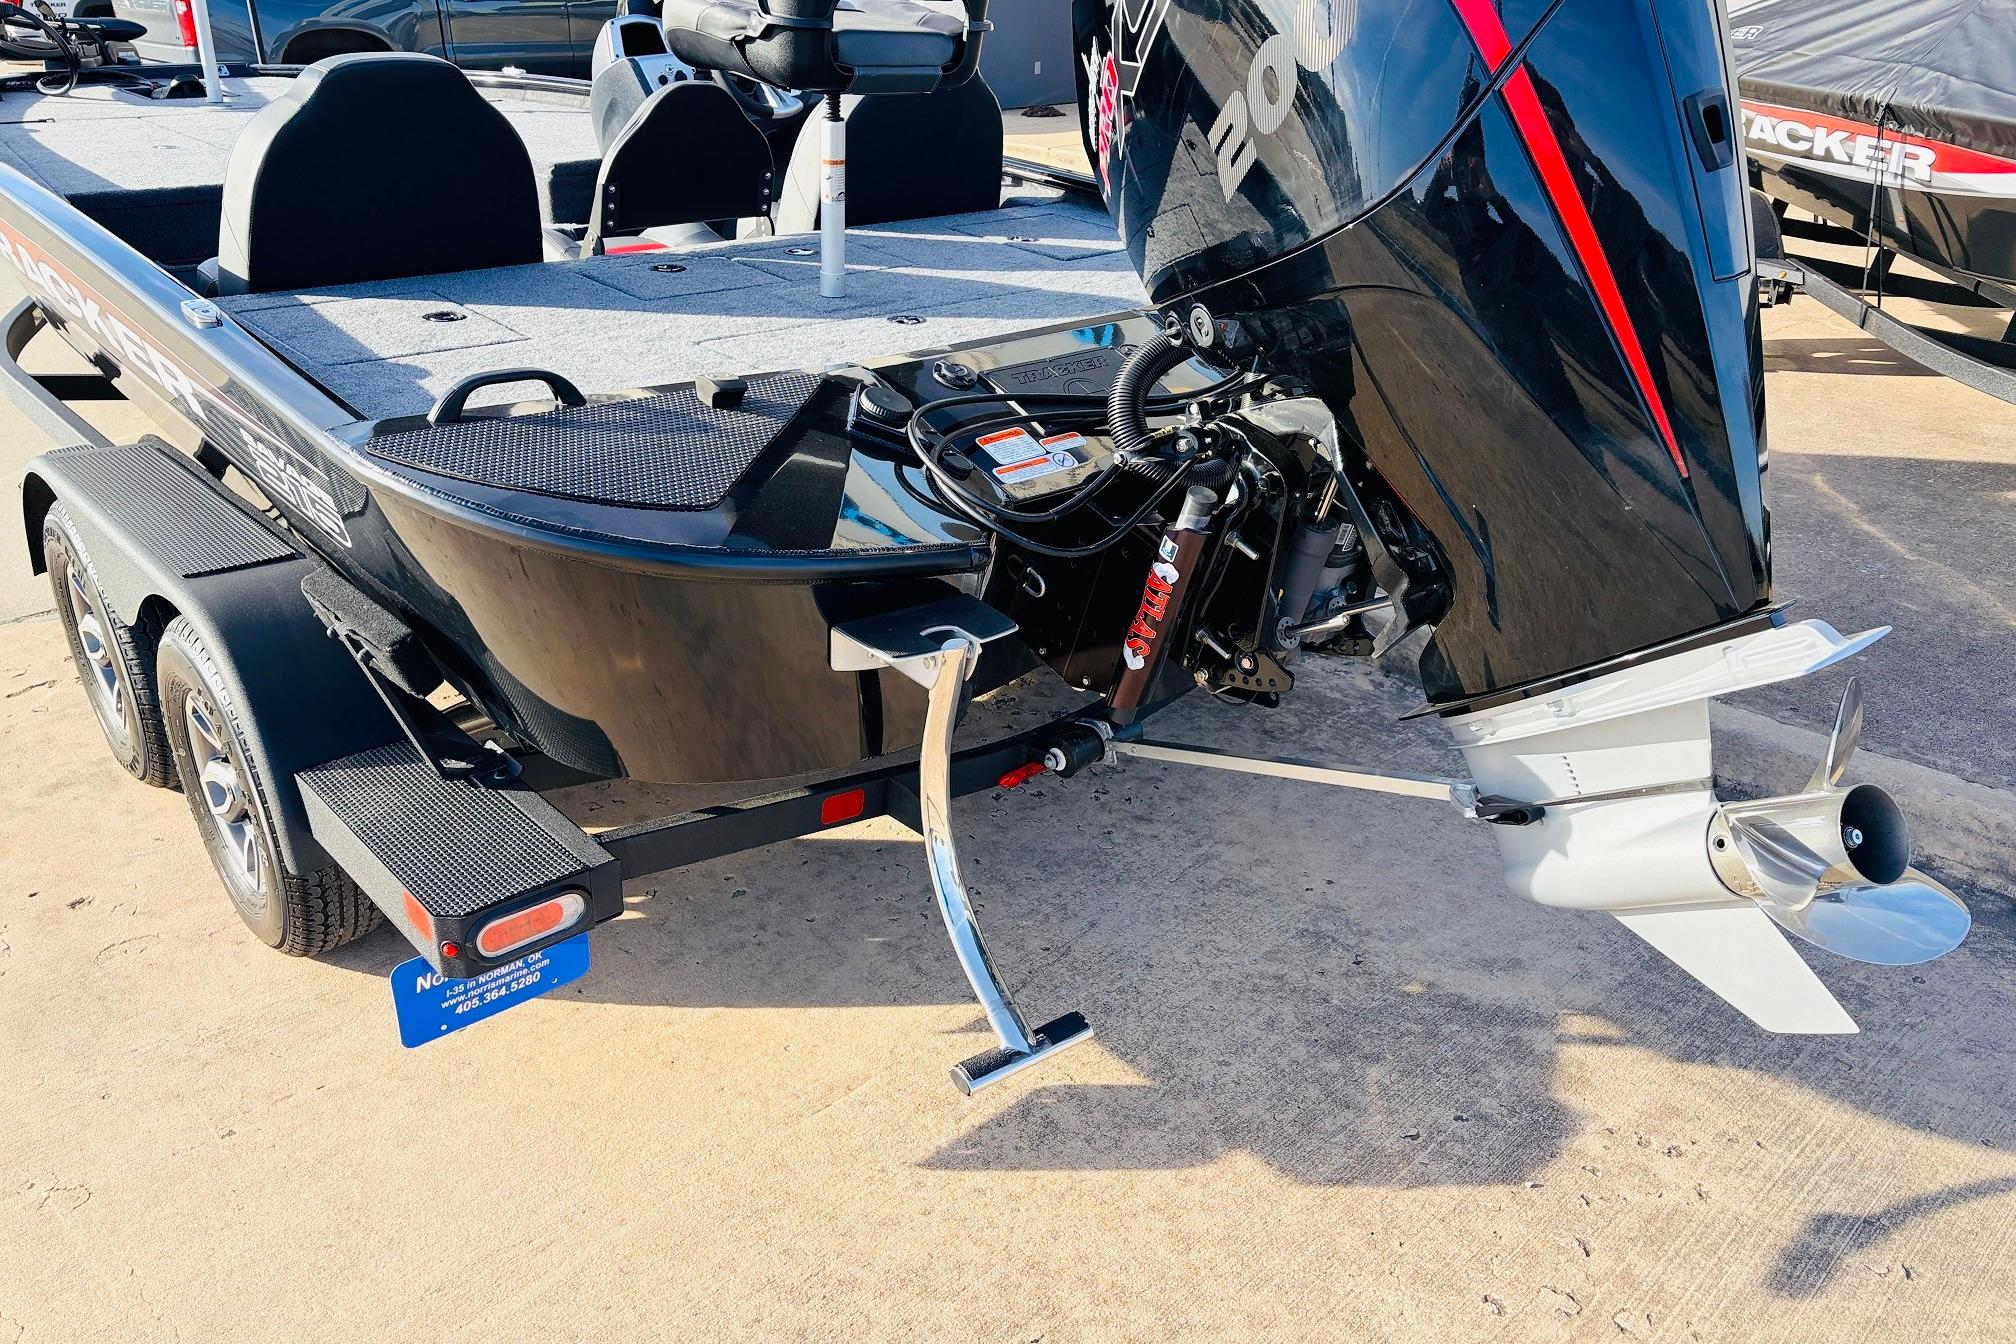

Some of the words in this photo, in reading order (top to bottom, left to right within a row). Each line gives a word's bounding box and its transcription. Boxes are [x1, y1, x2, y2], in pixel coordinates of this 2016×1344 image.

[1741, 108, 1937, 182] ACKER
[1011, 356, 1110, 385] TRACKER
[247, 443, 352, 548] 215
[441, 958, 551, 1009] www.norrismarine.com
[446, 984, 465, 998] I-35
[466, 979, 476, 990] in
[478, 960, 526, 986] NORMAN,
[528, 951, 544, 965] OK
[454, 971, 542, 1015] 405.364.5280
